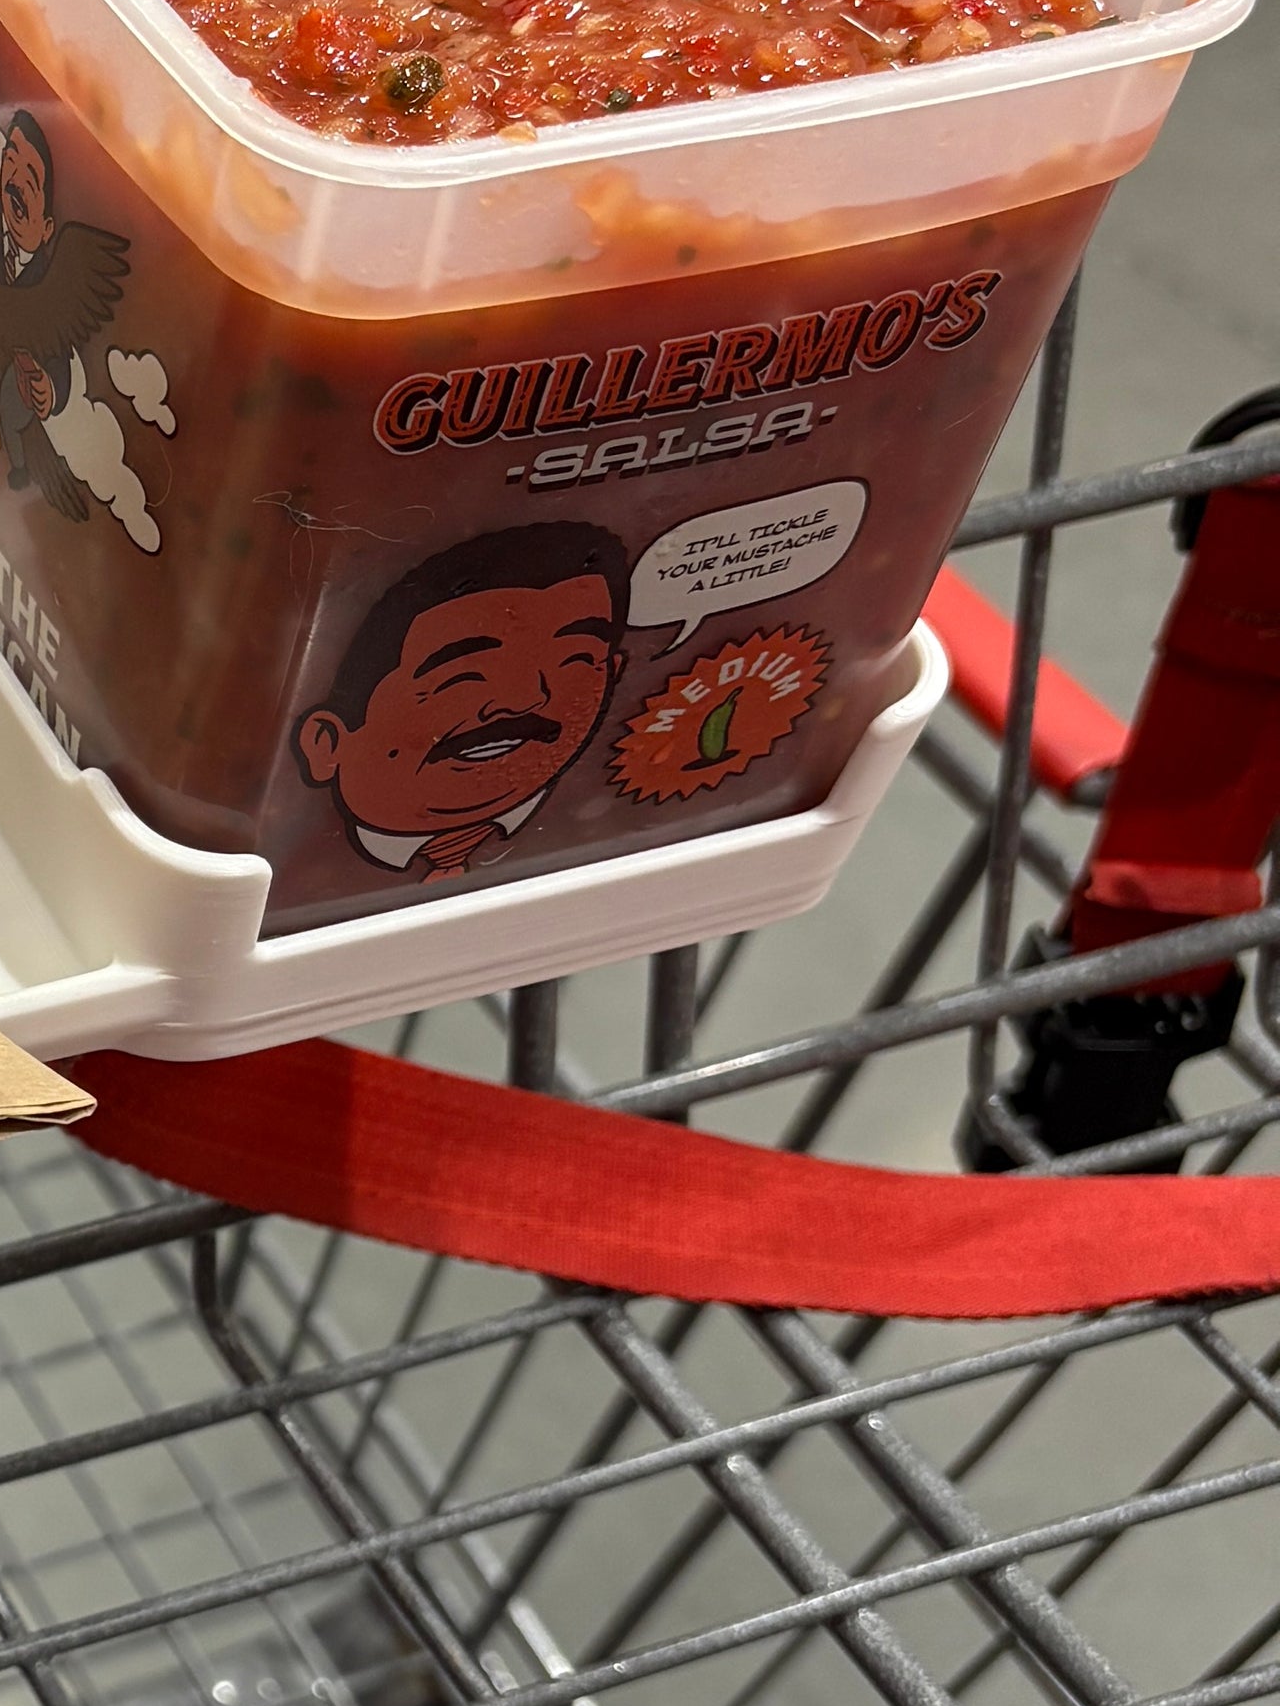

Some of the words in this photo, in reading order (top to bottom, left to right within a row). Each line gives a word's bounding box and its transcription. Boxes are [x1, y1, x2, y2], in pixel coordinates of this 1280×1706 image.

[373, 269, 1003, 455] GUILLERMO'S
[657, 556, 718, 581] YOUR
[722, 525, 838, 568] MUSTACHE
[682, 532, 740, 557] IT'LL
[749, 508, 829, 541] TICKLE
[687, 579, 704, 594] A
[710, 556, 791, 588] LITTLE!
[644, 650, 802, 733] MEDIUM
